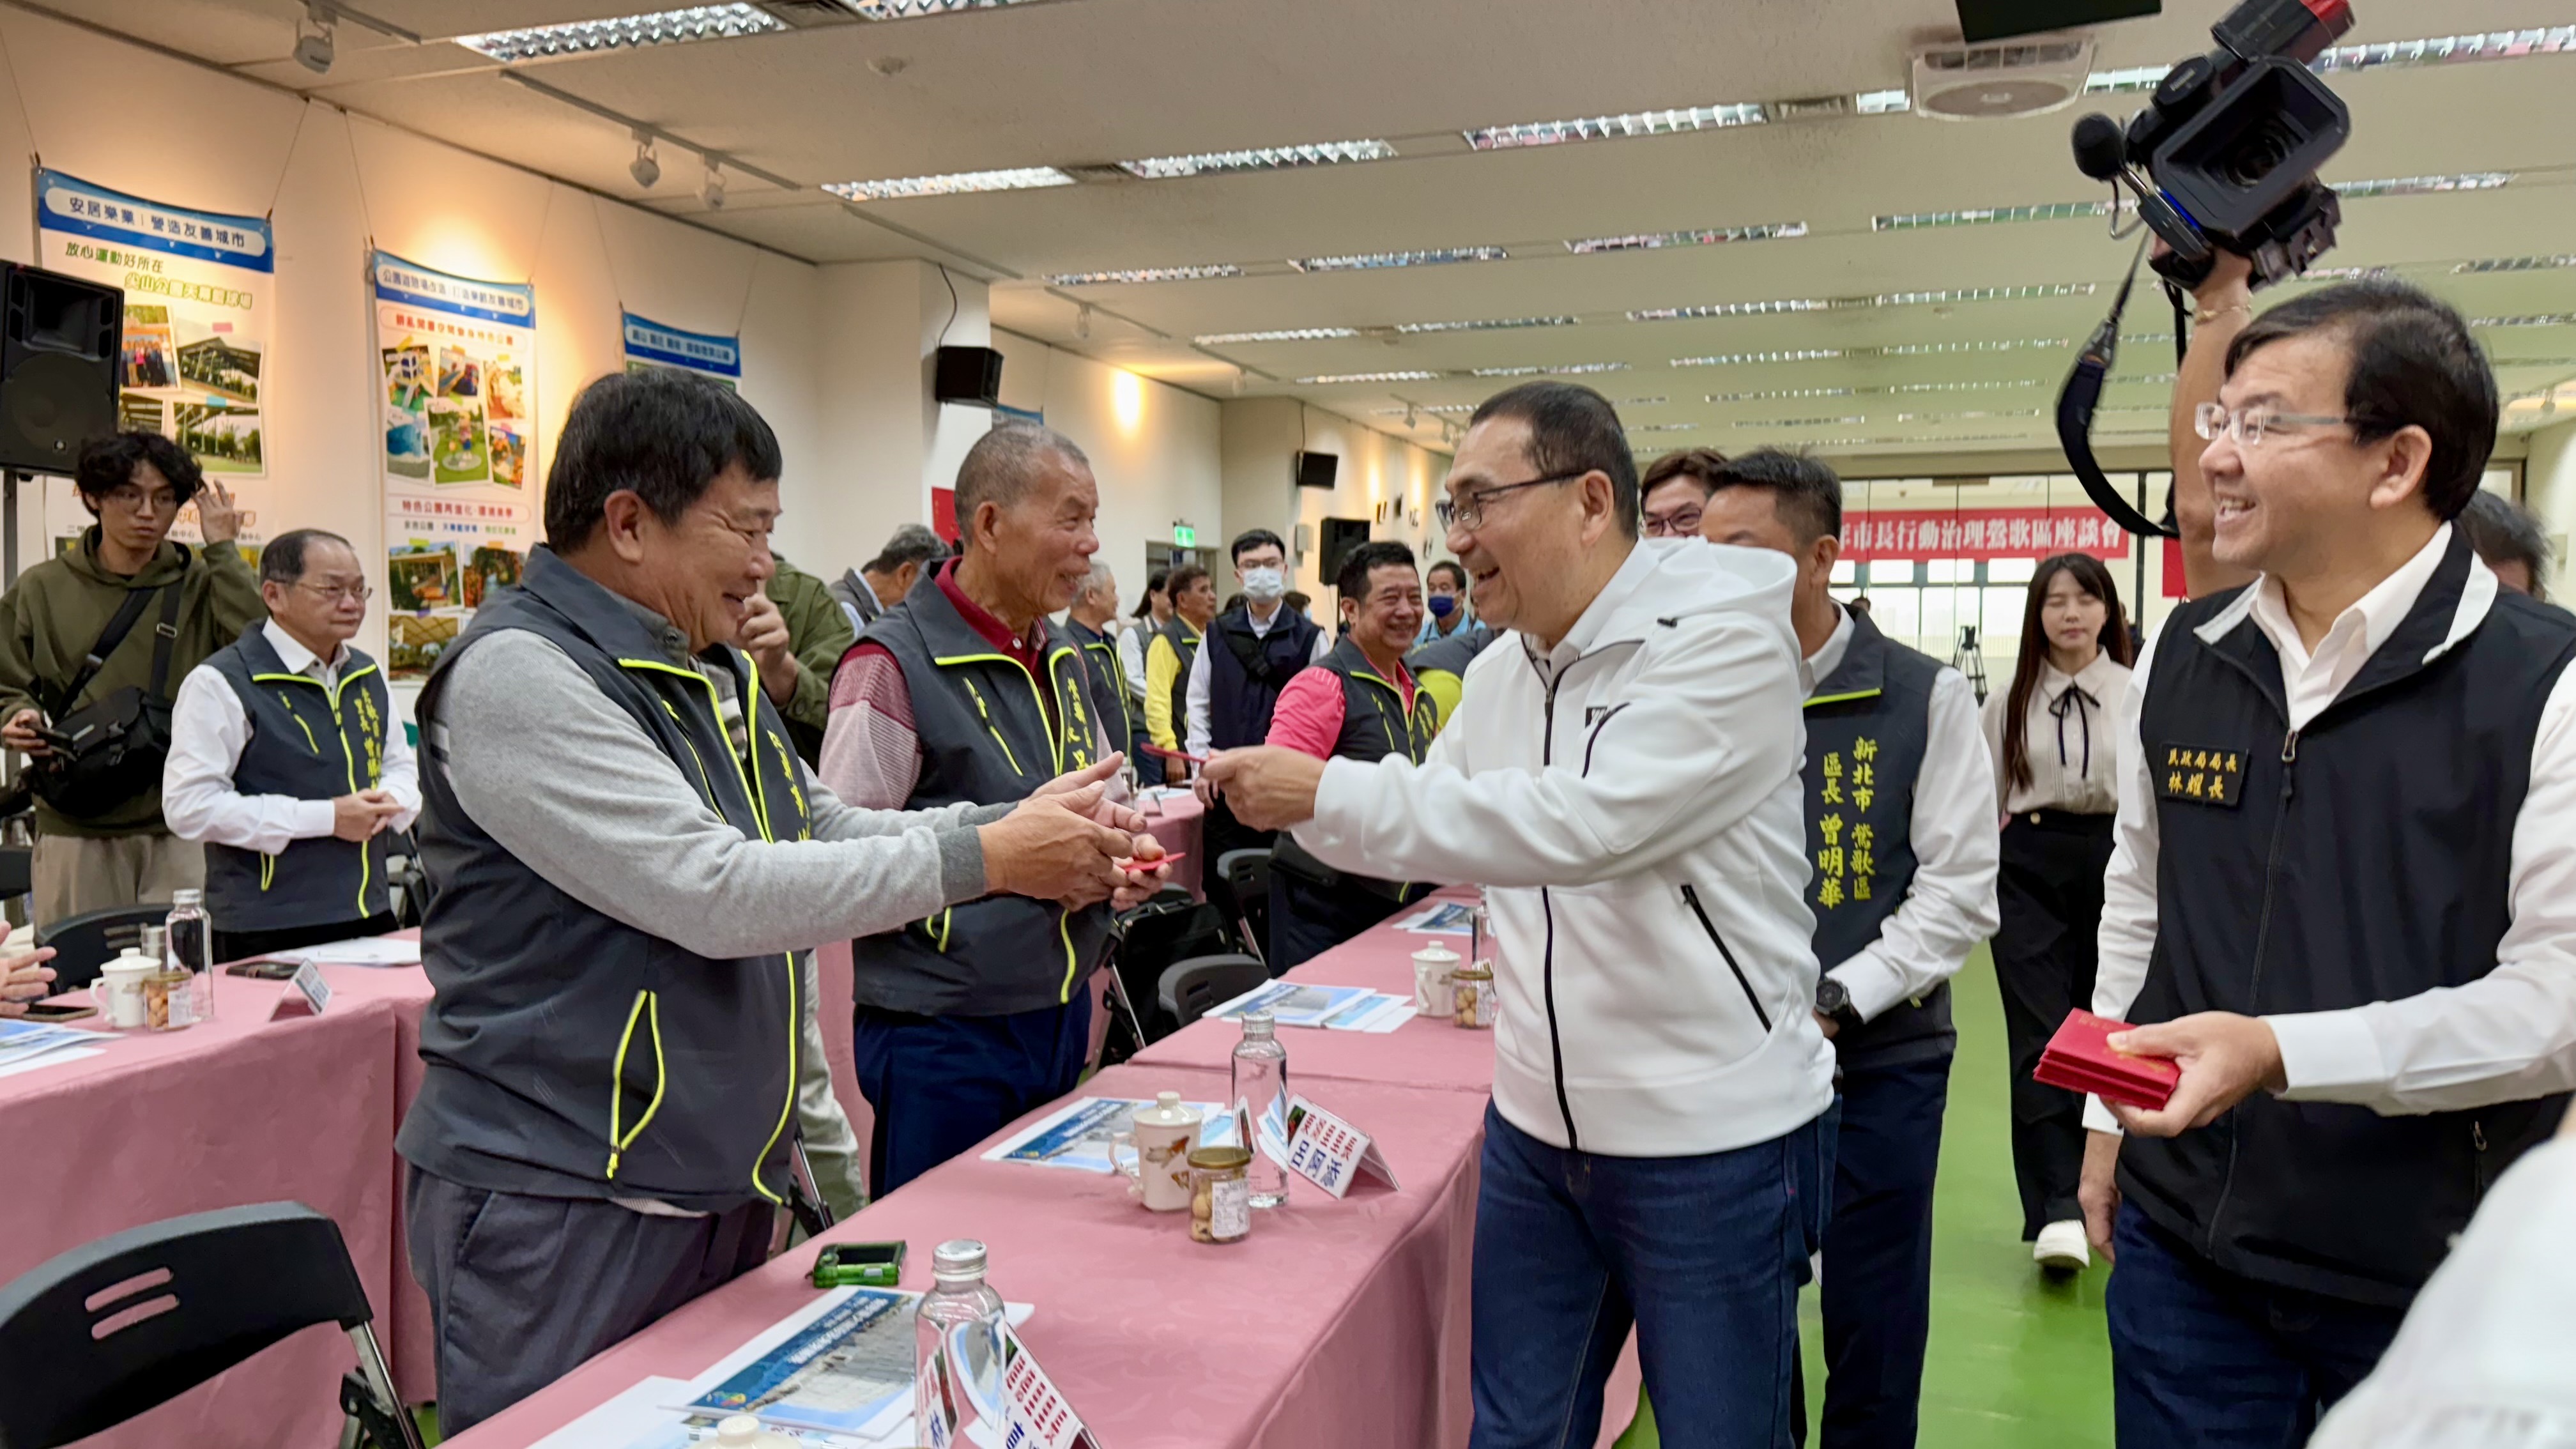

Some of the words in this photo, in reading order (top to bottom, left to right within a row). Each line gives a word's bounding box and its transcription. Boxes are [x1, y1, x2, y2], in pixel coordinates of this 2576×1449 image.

[69, 196, 135, 226] 安居樂業
[151, 215, 245, 249] 營造友善城市
[65, 241, 164, 275] 放心運動好所在
[1822, 751, 1844, 804] 區長
[1852, 736, 1878, 814] 新北市
[1818, 812, 1845, 910] 曾明華
[1850, 822, 1876, 901] 鶯歌區
